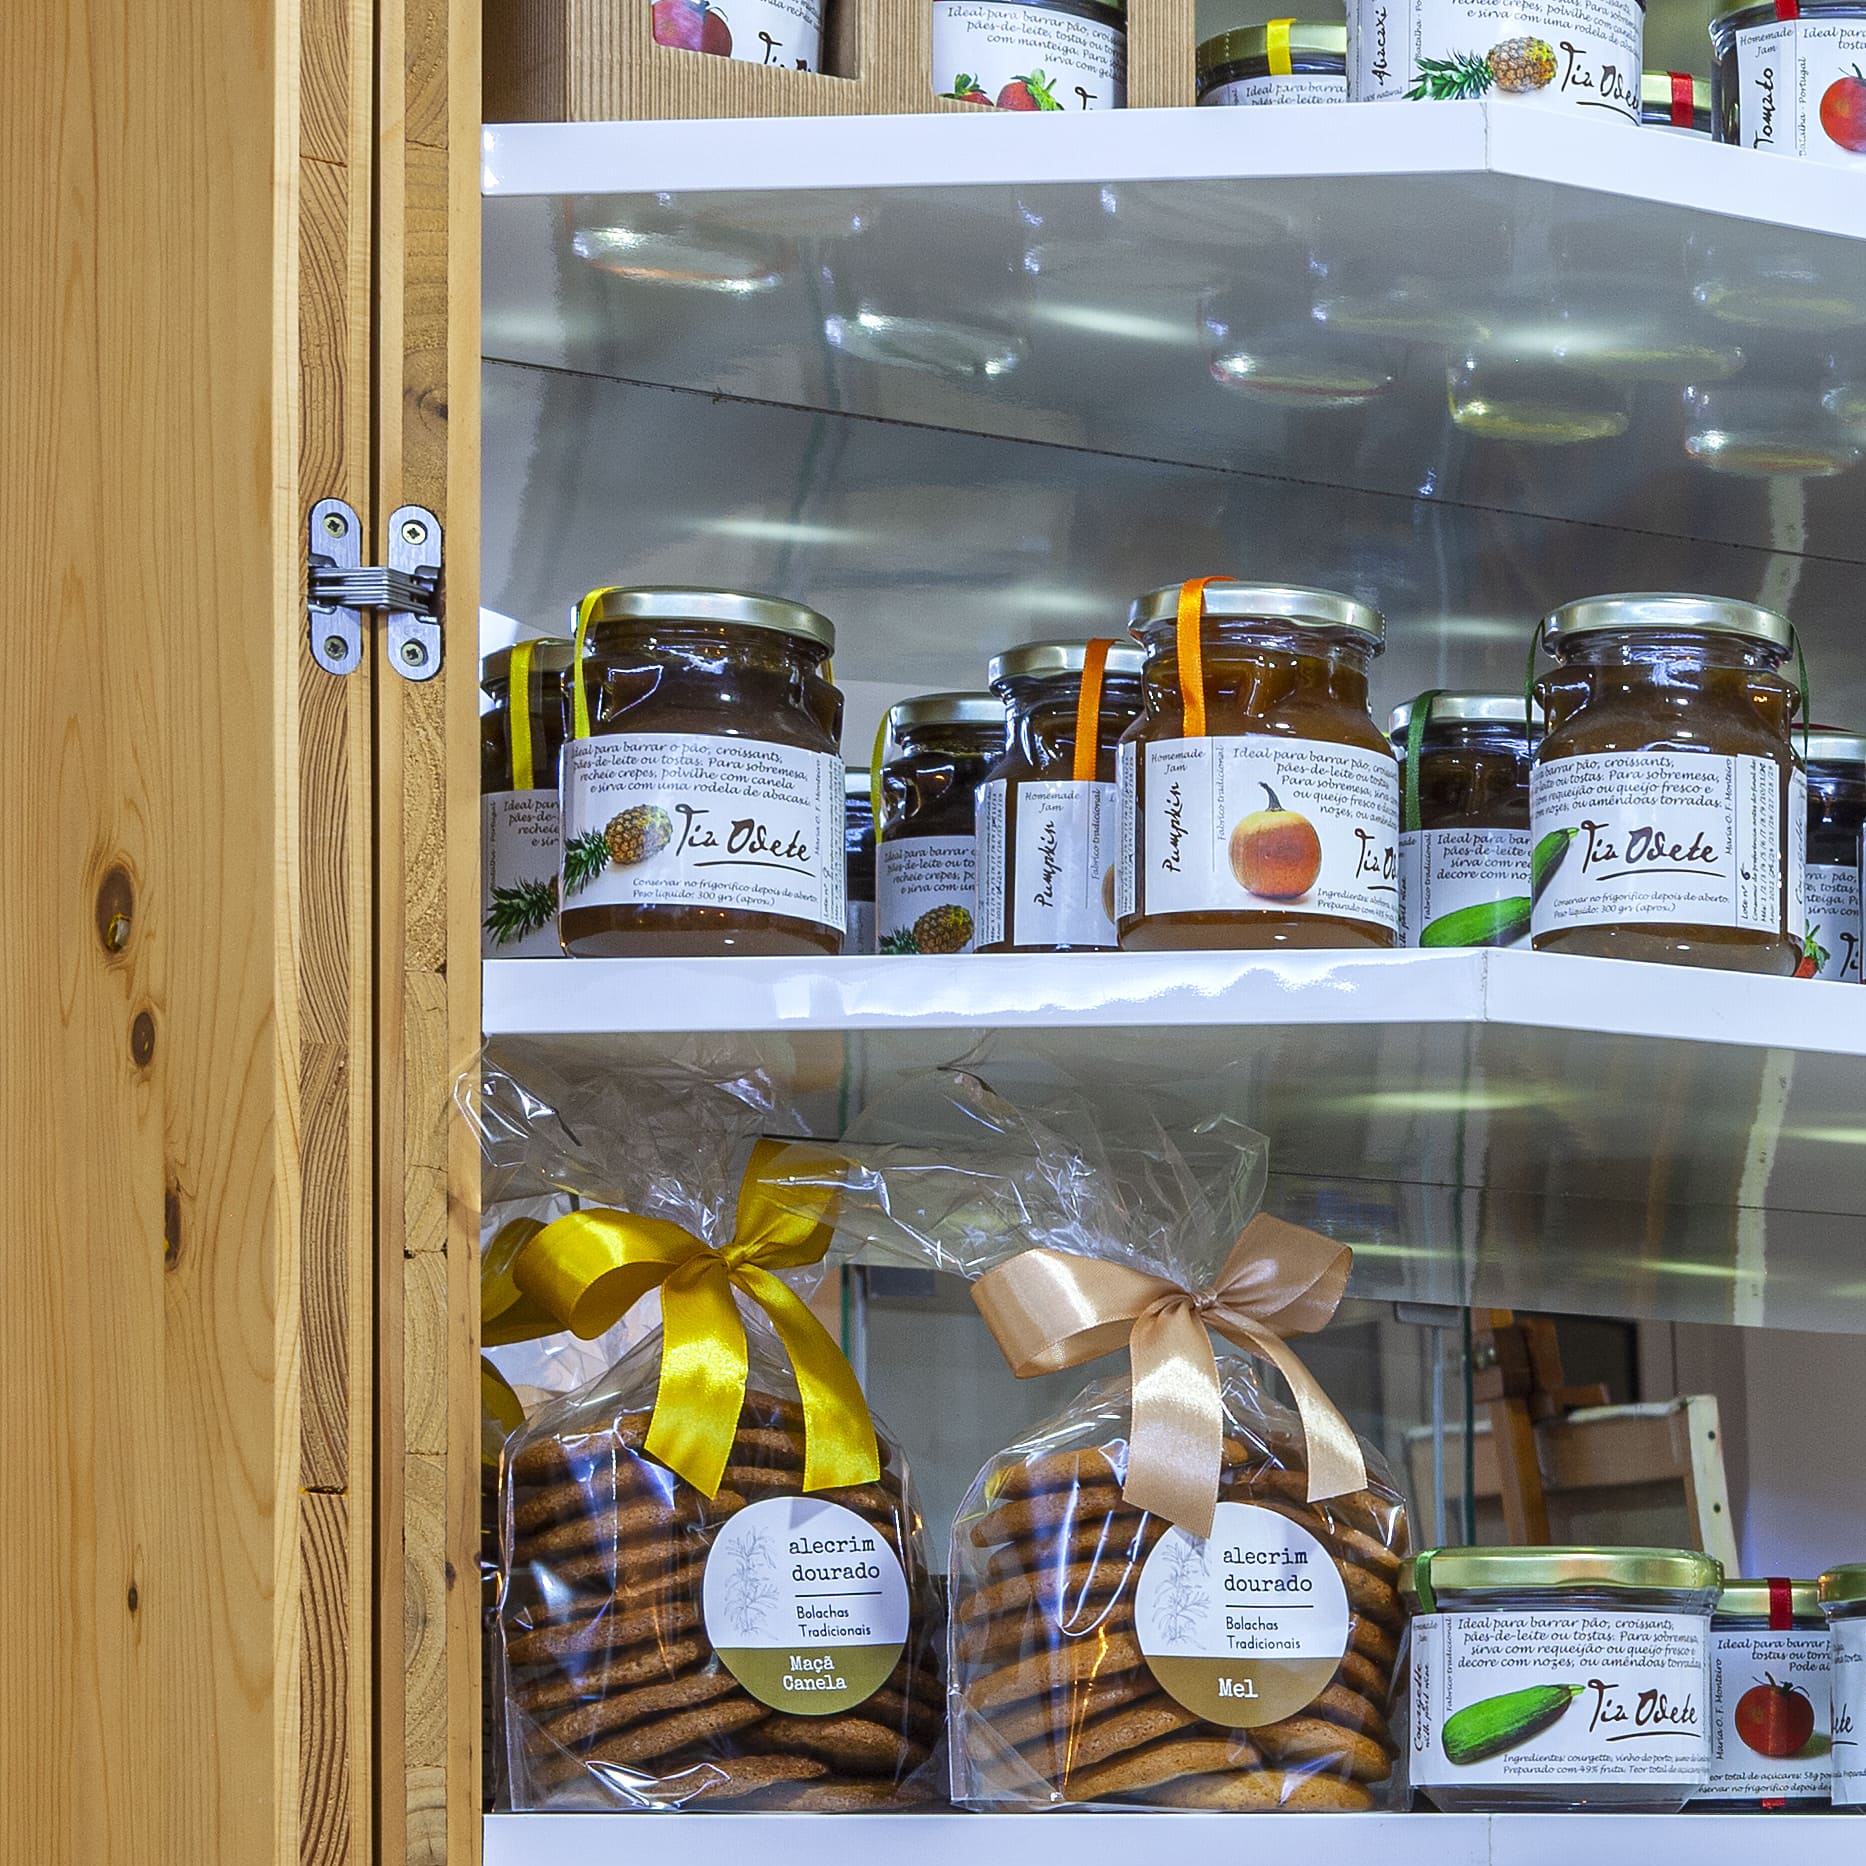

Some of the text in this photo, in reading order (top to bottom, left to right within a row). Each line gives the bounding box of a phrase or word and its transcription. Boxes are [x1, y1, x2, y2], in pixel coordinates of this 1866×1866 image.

[1753, 66, 1774, 149] Tomato
[1151, 751, 1204, 764] Homemade
[1604, 757, 1675, 768] croissants,
[1164, 764, 1188, 774] Jam
[1609, 770, 1720, 783] Para sobremesa,
[1617, 782, 1700, 795] queijo fresco
[1589, 794, 1722, 808] amêndoas torradas.
[675, 803, 811, 862] Tia Odete
[1162, 781, 1189, 873] Pumpkin
[1581, 820, 1718, 874] Tia Odete
[1033, 820, 1063, 909] Pumpkin
[789, 1536, 875, 1554] alecrim
[1223, 1547, 1309, 1564] alecrim
[792, 1562, 880, 1582] dourado
[1224, 1575, 1313, 1592] dourado
[797, 1604, 850, 1620] Bolachas
[799, 1624, 872, 1638] Tradicionais
[1226, 1616, 1278, 1631] Bolachas
[1458, 1617, 1610, 1635] Ideal para barrar pão,
[1227, 1635, 1301, 1649] Tradicionais
[1464, 1630, 1547, 1645] pães-de-leite
[1573, 1631, 1615, 1641] tostas.
[1619, 1631, 1650, 1642] Para
[1505, 1644, 1604, 1659] com requeijão
[790, 1656, 834, 1672] Maçã
[783, 1674, 847, 1691] Canela
[1218, 1678, 1259, 1698] Mel
[1587, 1679, 1698, 1732] Tia Odete
